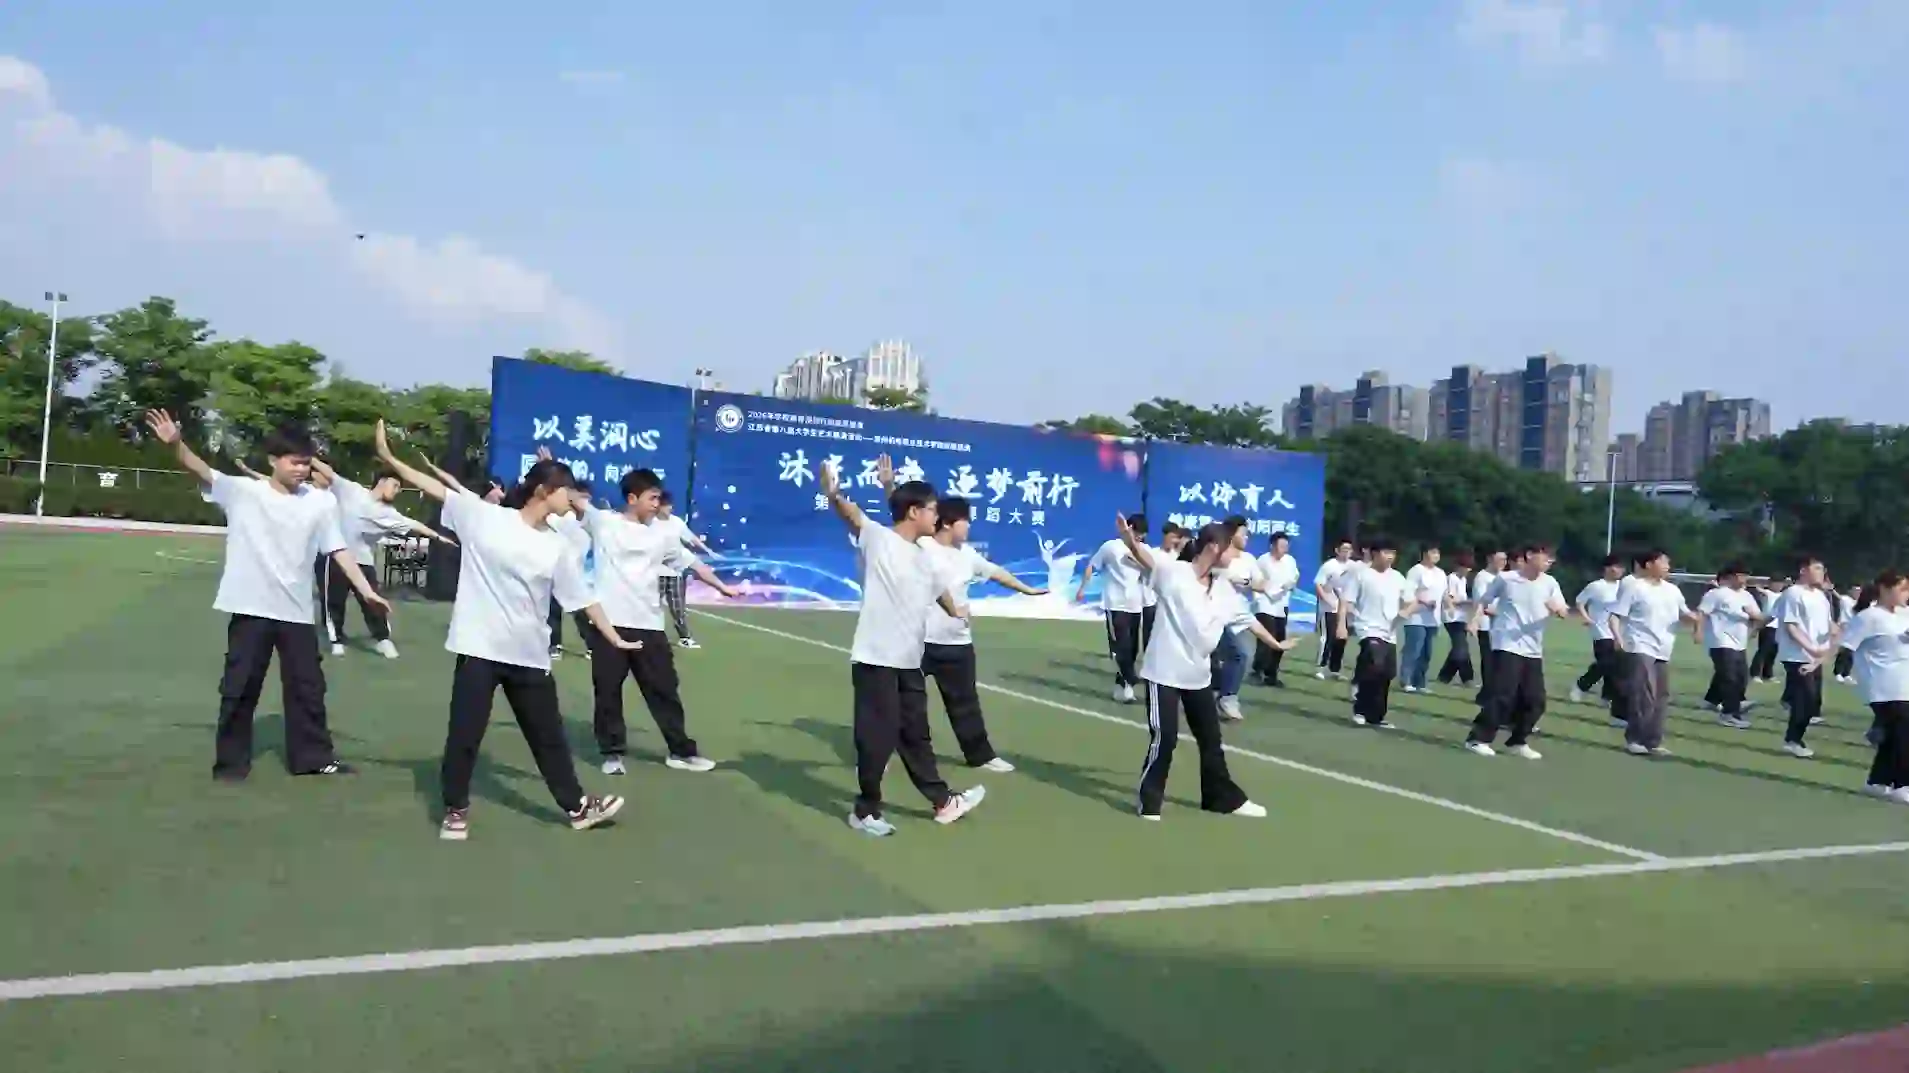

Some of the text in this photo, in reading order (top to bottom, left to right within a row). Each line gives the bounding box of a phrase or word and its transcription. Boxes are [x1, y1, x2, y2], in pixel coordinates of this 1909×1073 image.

[533, 414, 661, 452] 以美润心
[946, 464, 1081, 508] 逐梦前行
[1179, 481, 1296, 512] 以体育人
